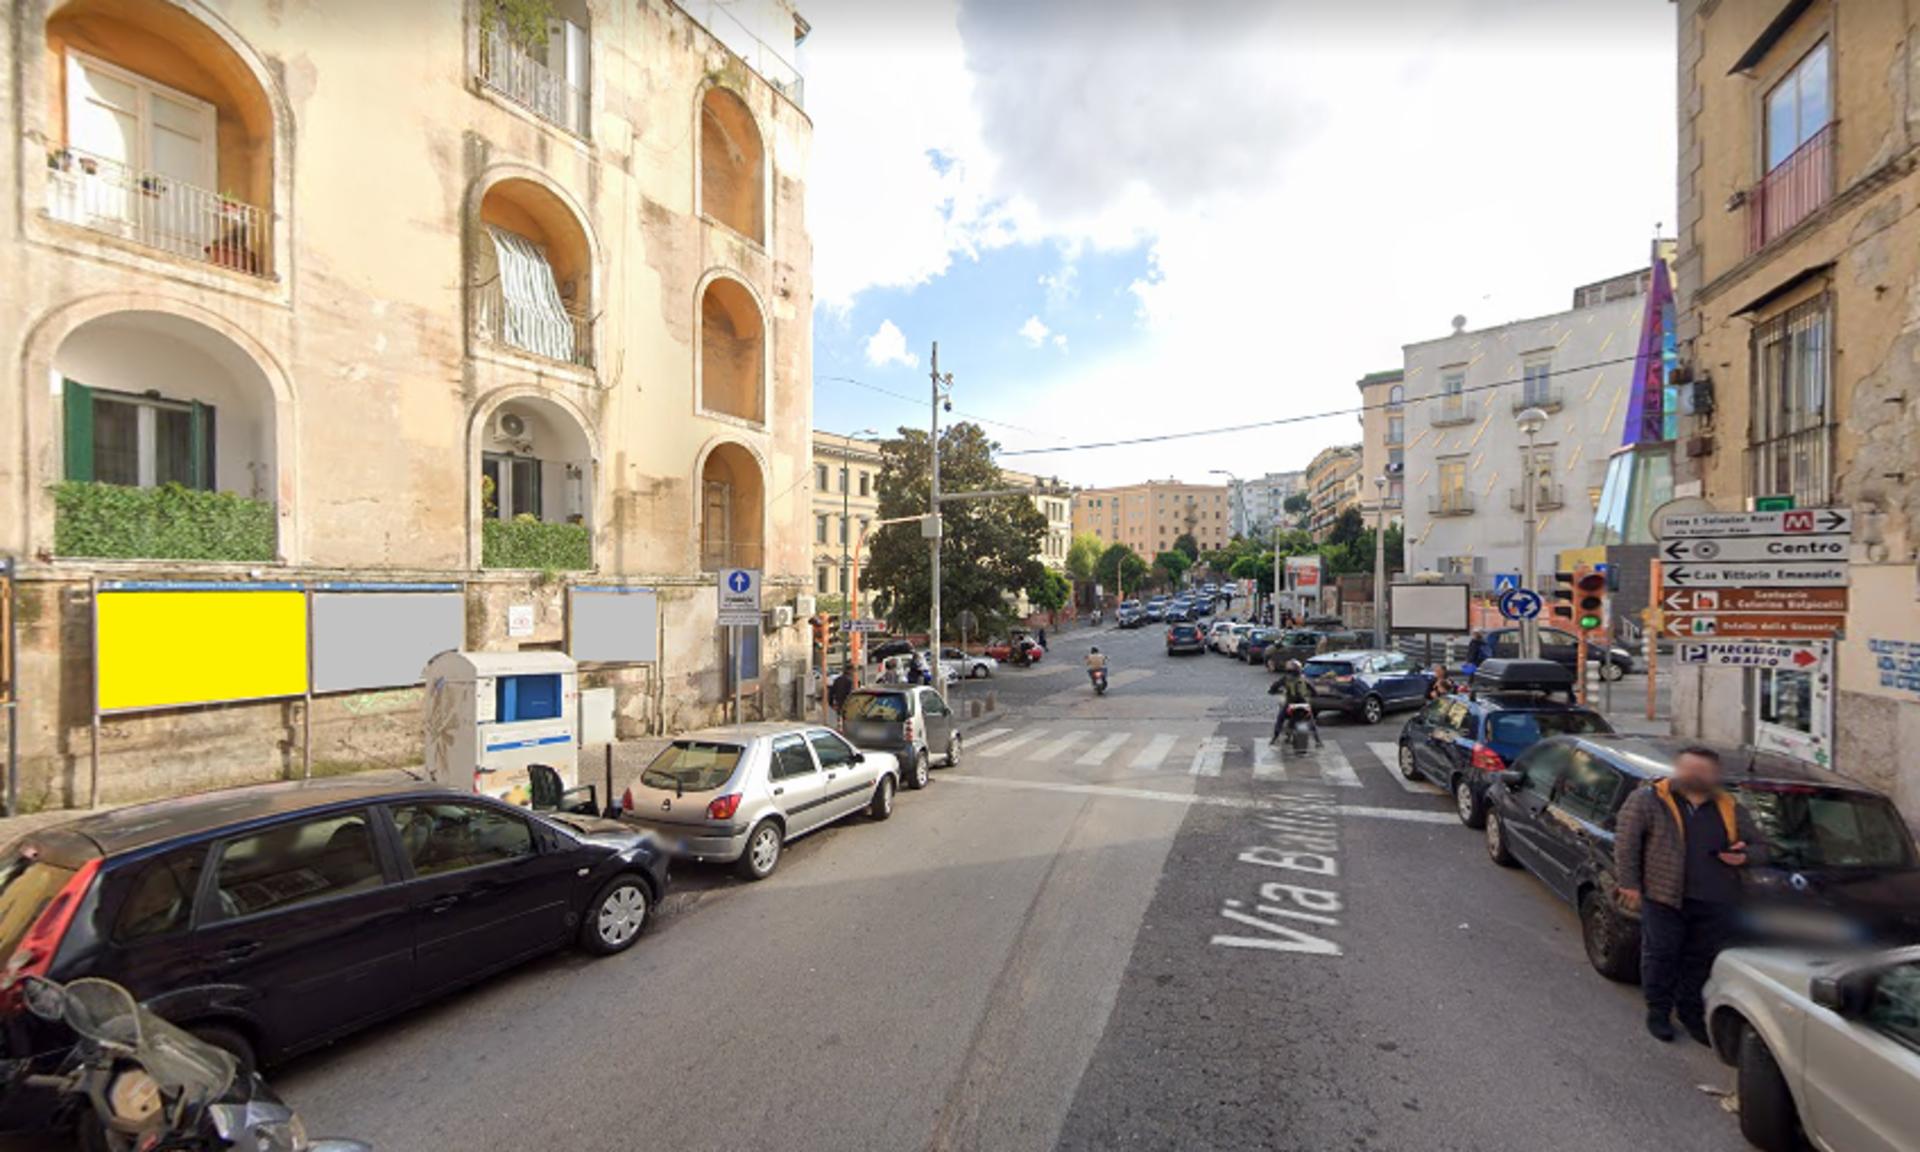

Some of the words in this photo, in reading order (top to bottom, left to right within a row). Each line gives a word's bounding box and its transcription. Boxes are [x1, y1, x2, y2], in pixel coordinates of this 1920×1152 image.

[1767, 541, 1842, 555] Centro
[1722, 569, 1771, 581] Vittorio
[1777, 569, 1842, 580] Emanuele
[1754, 590, 1808, 600] Santuario
[1711, 644, 1792, 658] PARCHEGGIO
